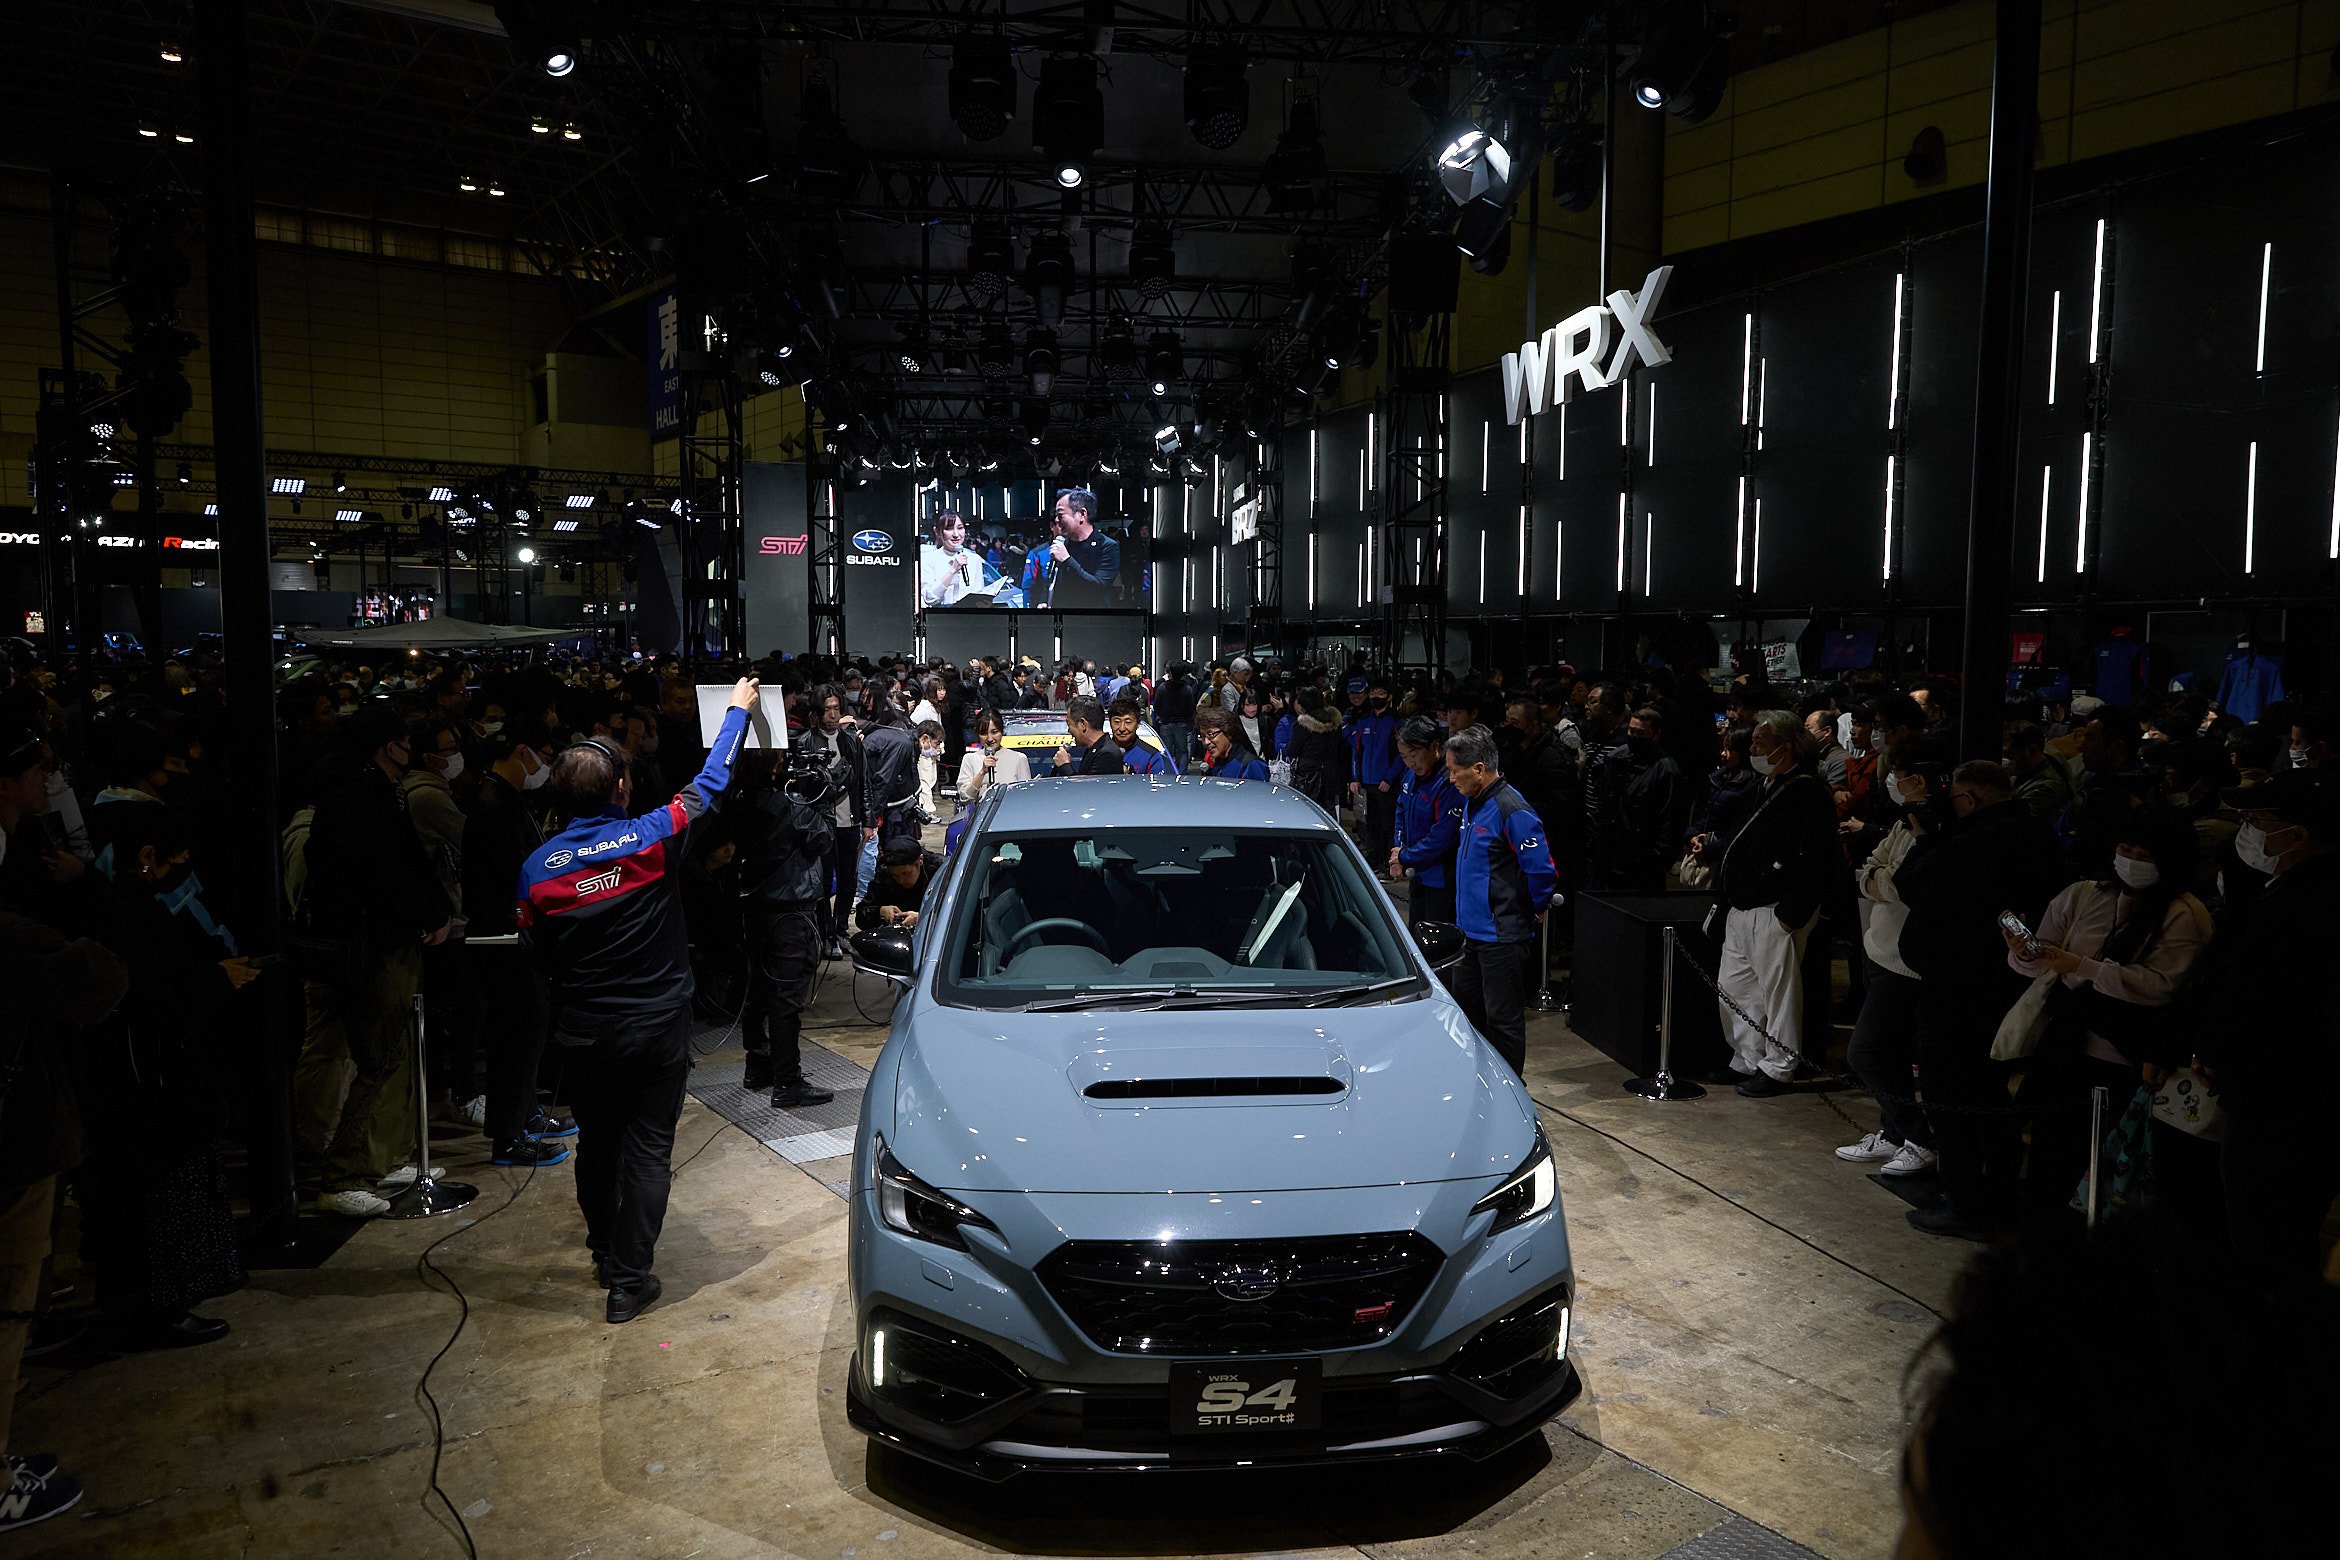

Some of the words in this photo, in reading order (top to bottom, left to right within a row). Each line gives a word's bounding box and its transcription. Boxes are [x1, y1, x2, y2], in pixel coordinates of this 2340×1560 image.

[1501, 265, 1674, 426] WRX
[655, 404, 680, 430] HALL
[163, 536, 220, 550] Racin
[846, 555, 900, 567] SUBARU
[577, 832, 638, 858] SUBARU
[1208, 1374, 1239, 1382] WRX
[1196, 1379, 1297, 1413] S4
[1198, 1415, 1231, 1426] STI
